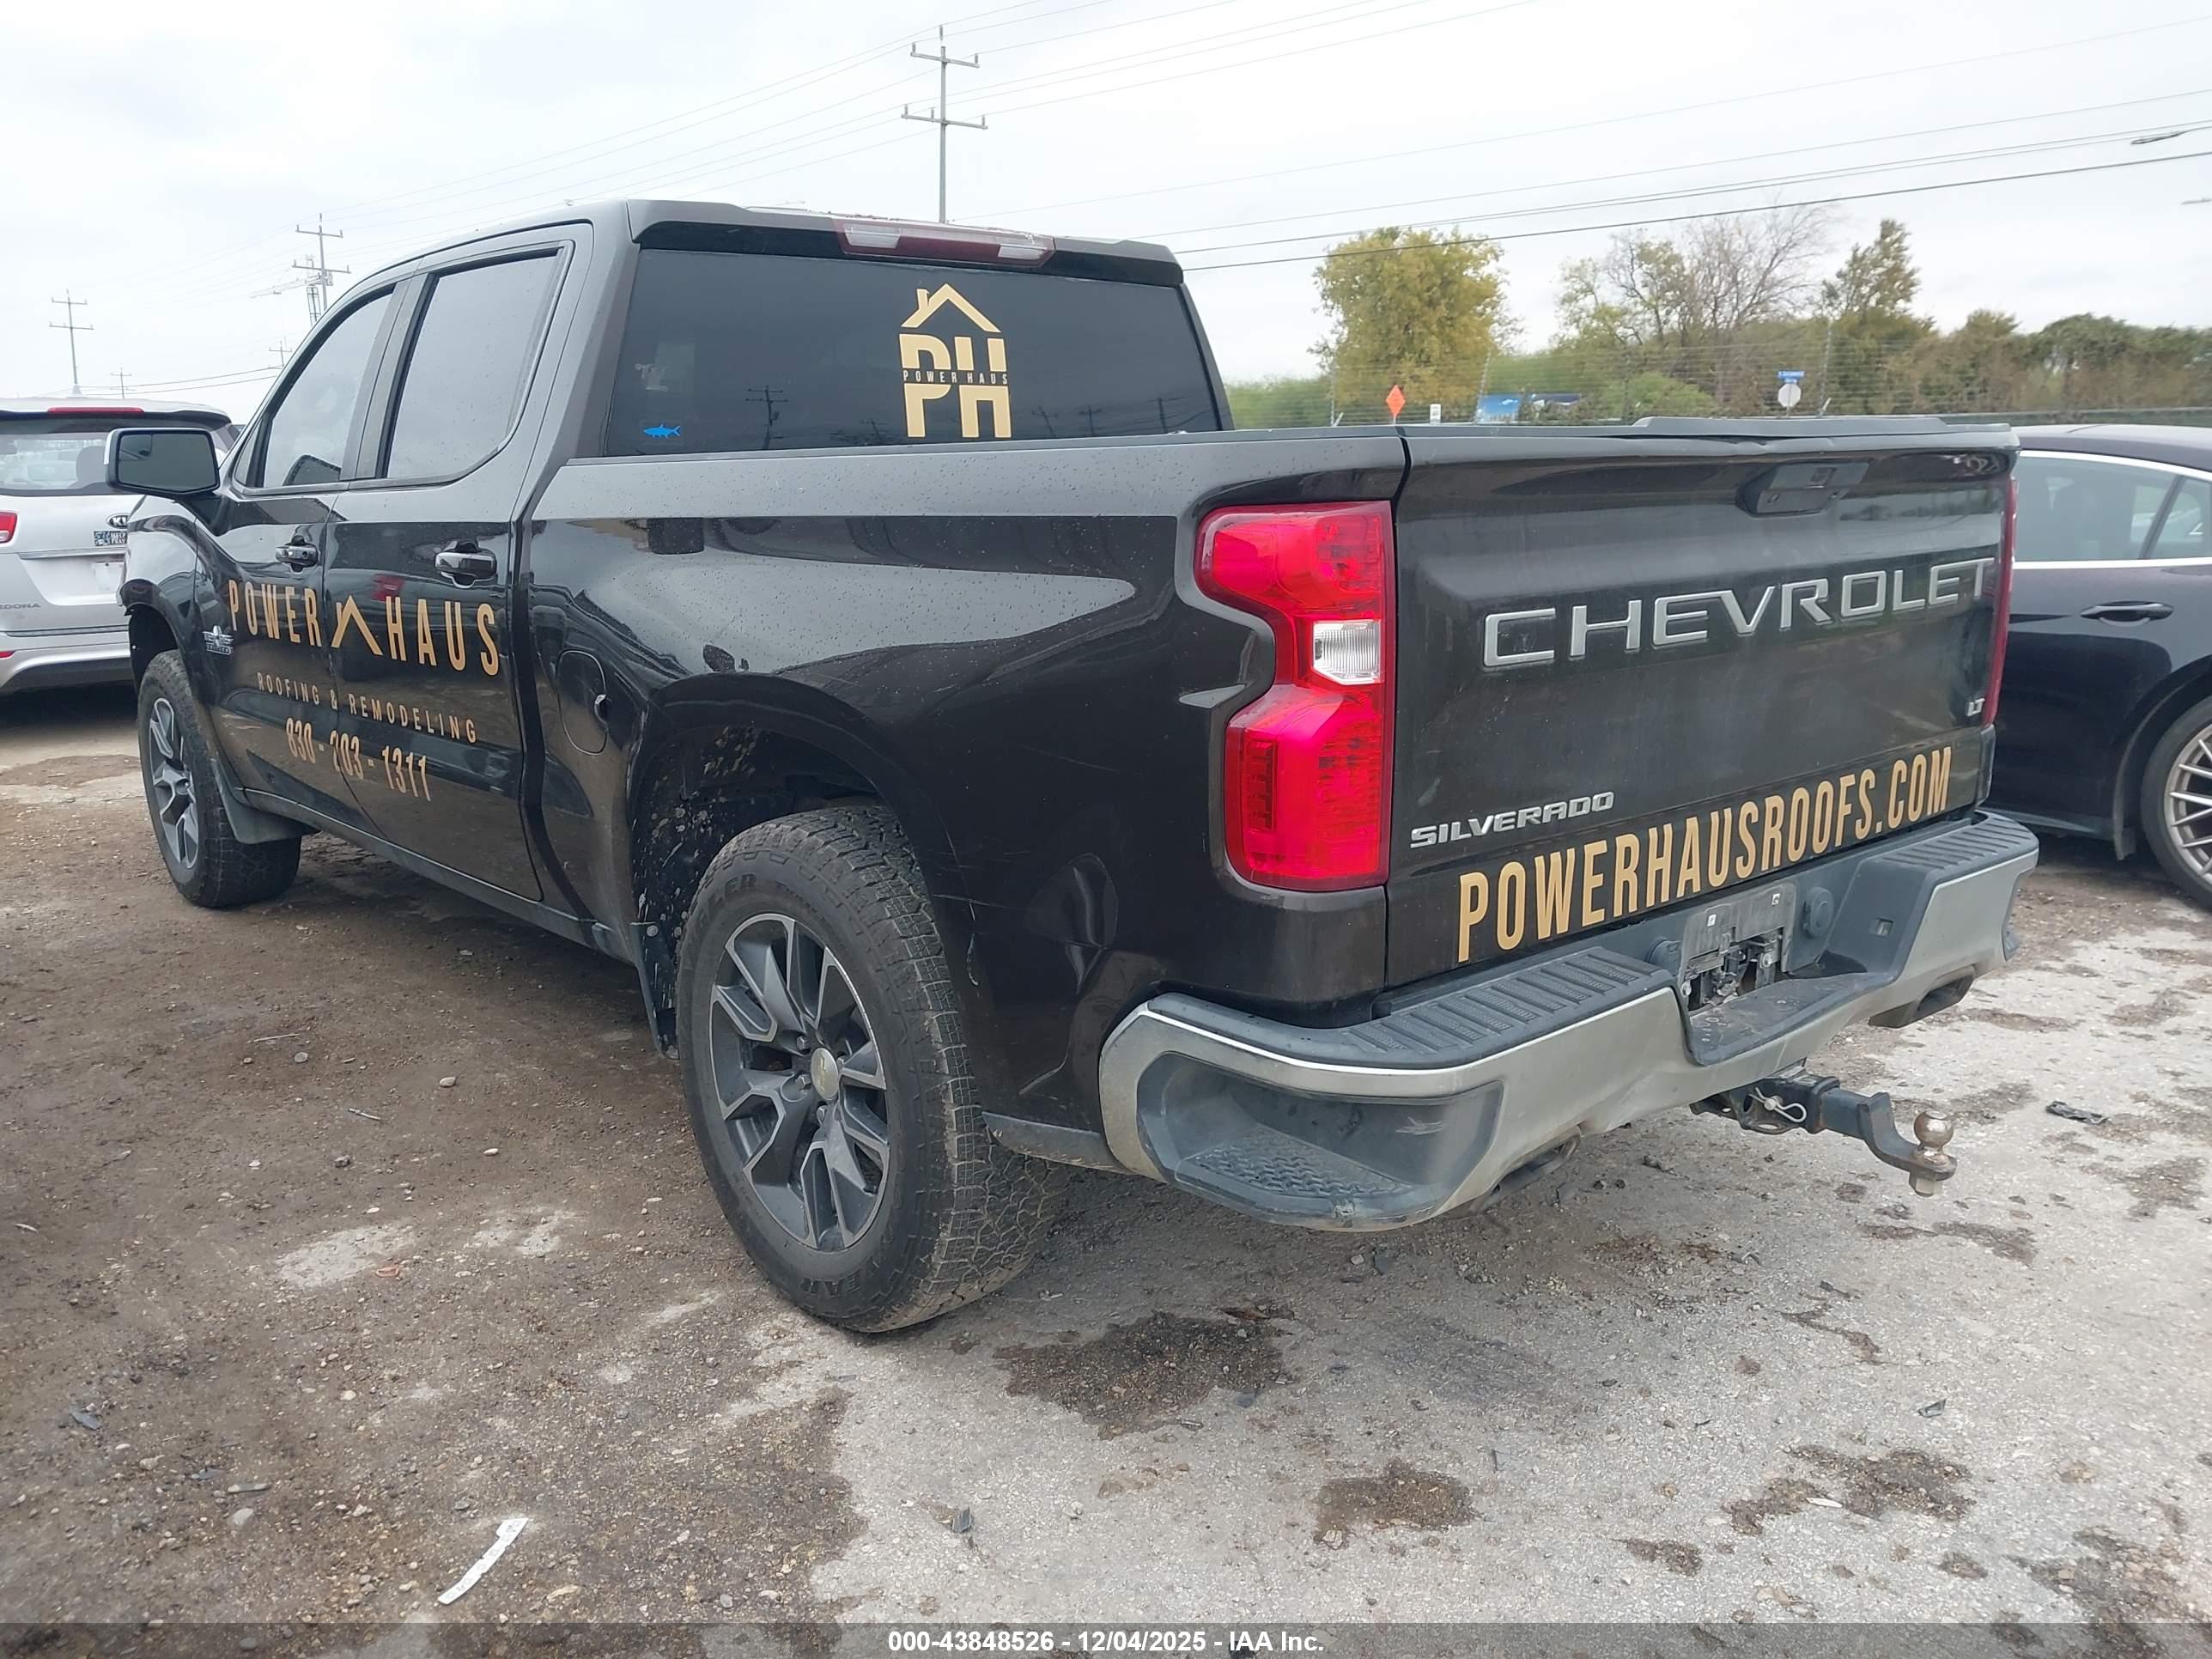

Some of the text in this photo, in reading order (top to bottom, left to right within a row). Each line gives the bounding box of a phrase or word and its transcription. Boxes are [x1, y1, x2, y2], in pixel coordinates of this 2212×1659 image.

[902, 370, 1008, 385] POWER HAUS
[228, 580, 500, 676] POWER HAUS
[1484, 557, 1995, 668] CHEVROLET
[257, 672, 477, 744] ROOFING & REMODELING
[1967, 698, 1985, 717] LT
[286, 717, 316, 763] 830
[330, 730, 364, 780] 203
[381, 745, 431, 802] 1311
[1411, 792, 1614, 848] SILVERADO
[1458, 746, 1953, 963] POWERHAUSROOFS.COM
